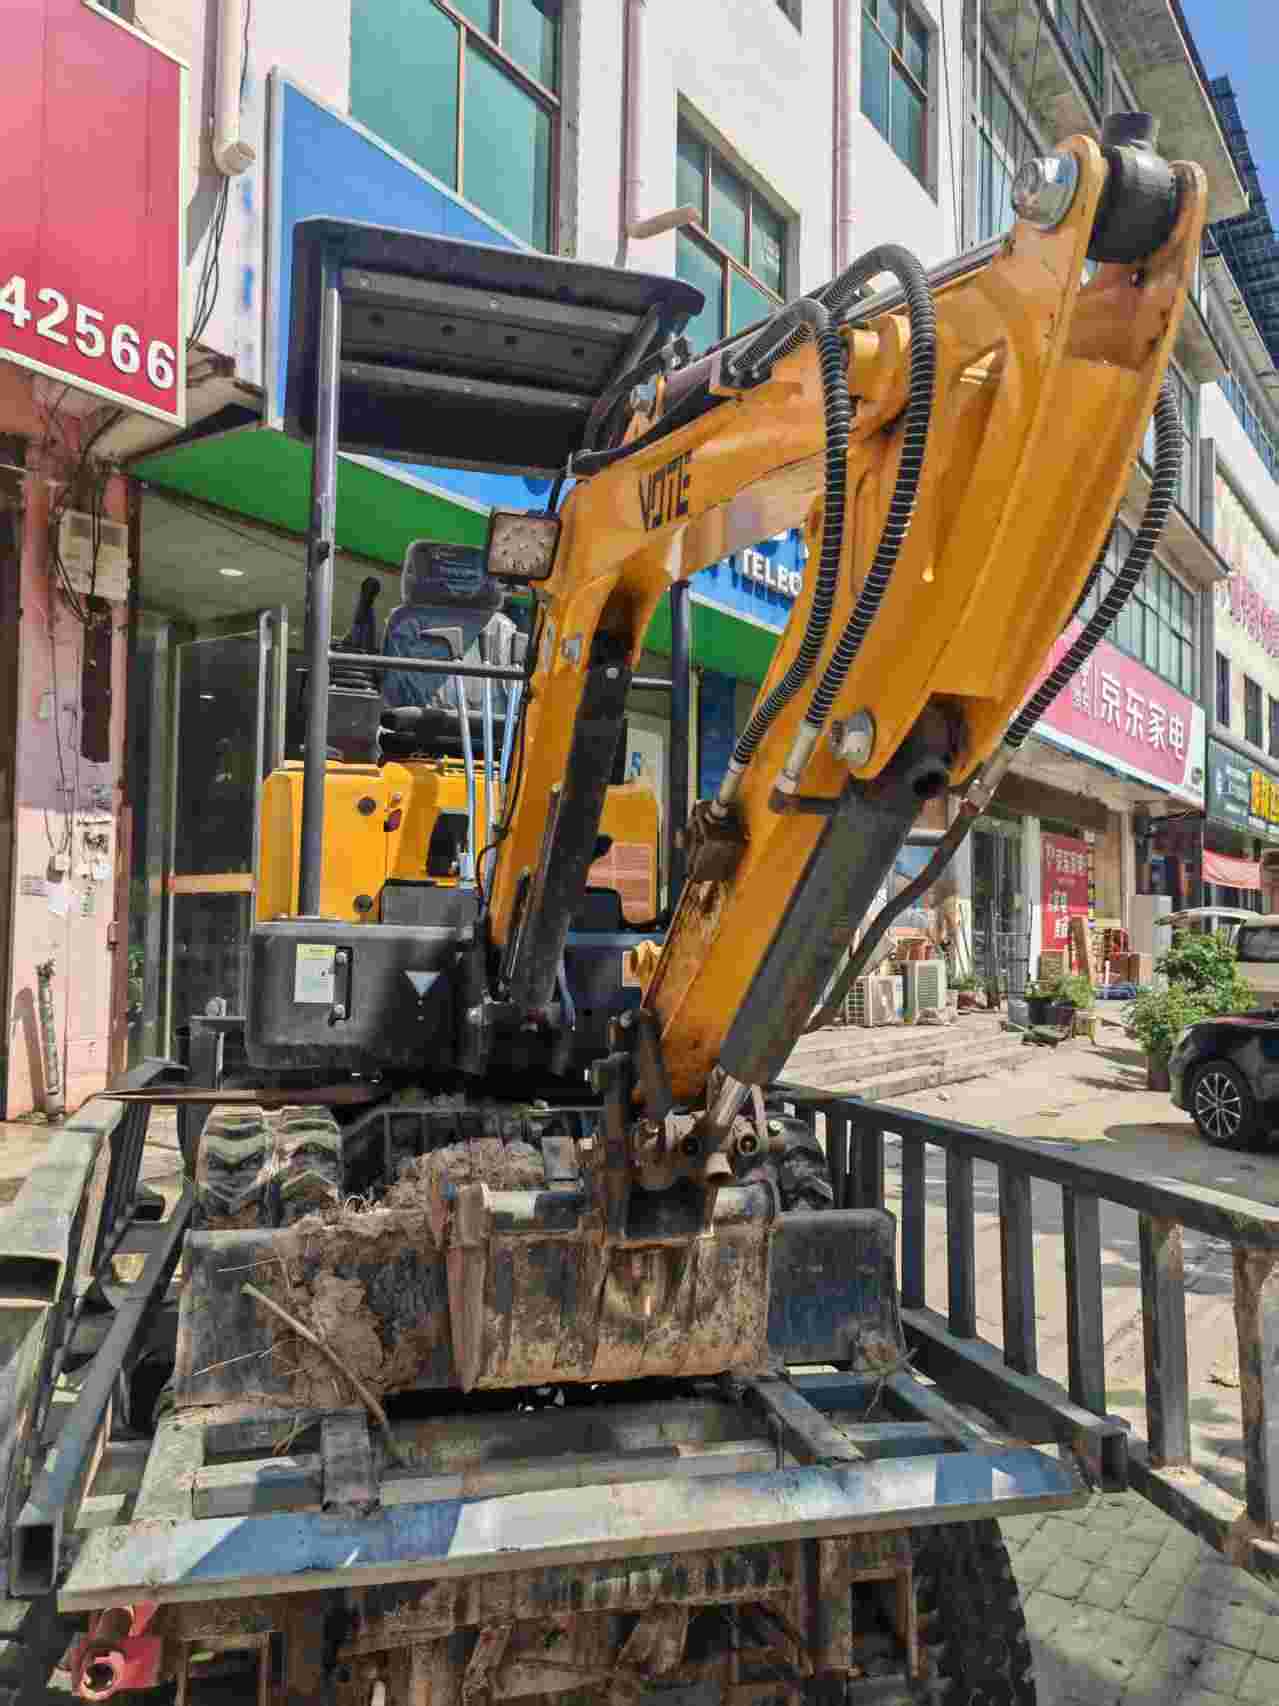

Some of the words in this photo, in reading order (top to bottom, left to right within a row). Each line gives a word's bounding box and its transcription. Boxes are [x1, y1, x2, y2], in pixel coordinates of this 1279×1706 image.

[0, 274, 175, 389] 42566
[1101, 671, 1185, 760] 京东家电
